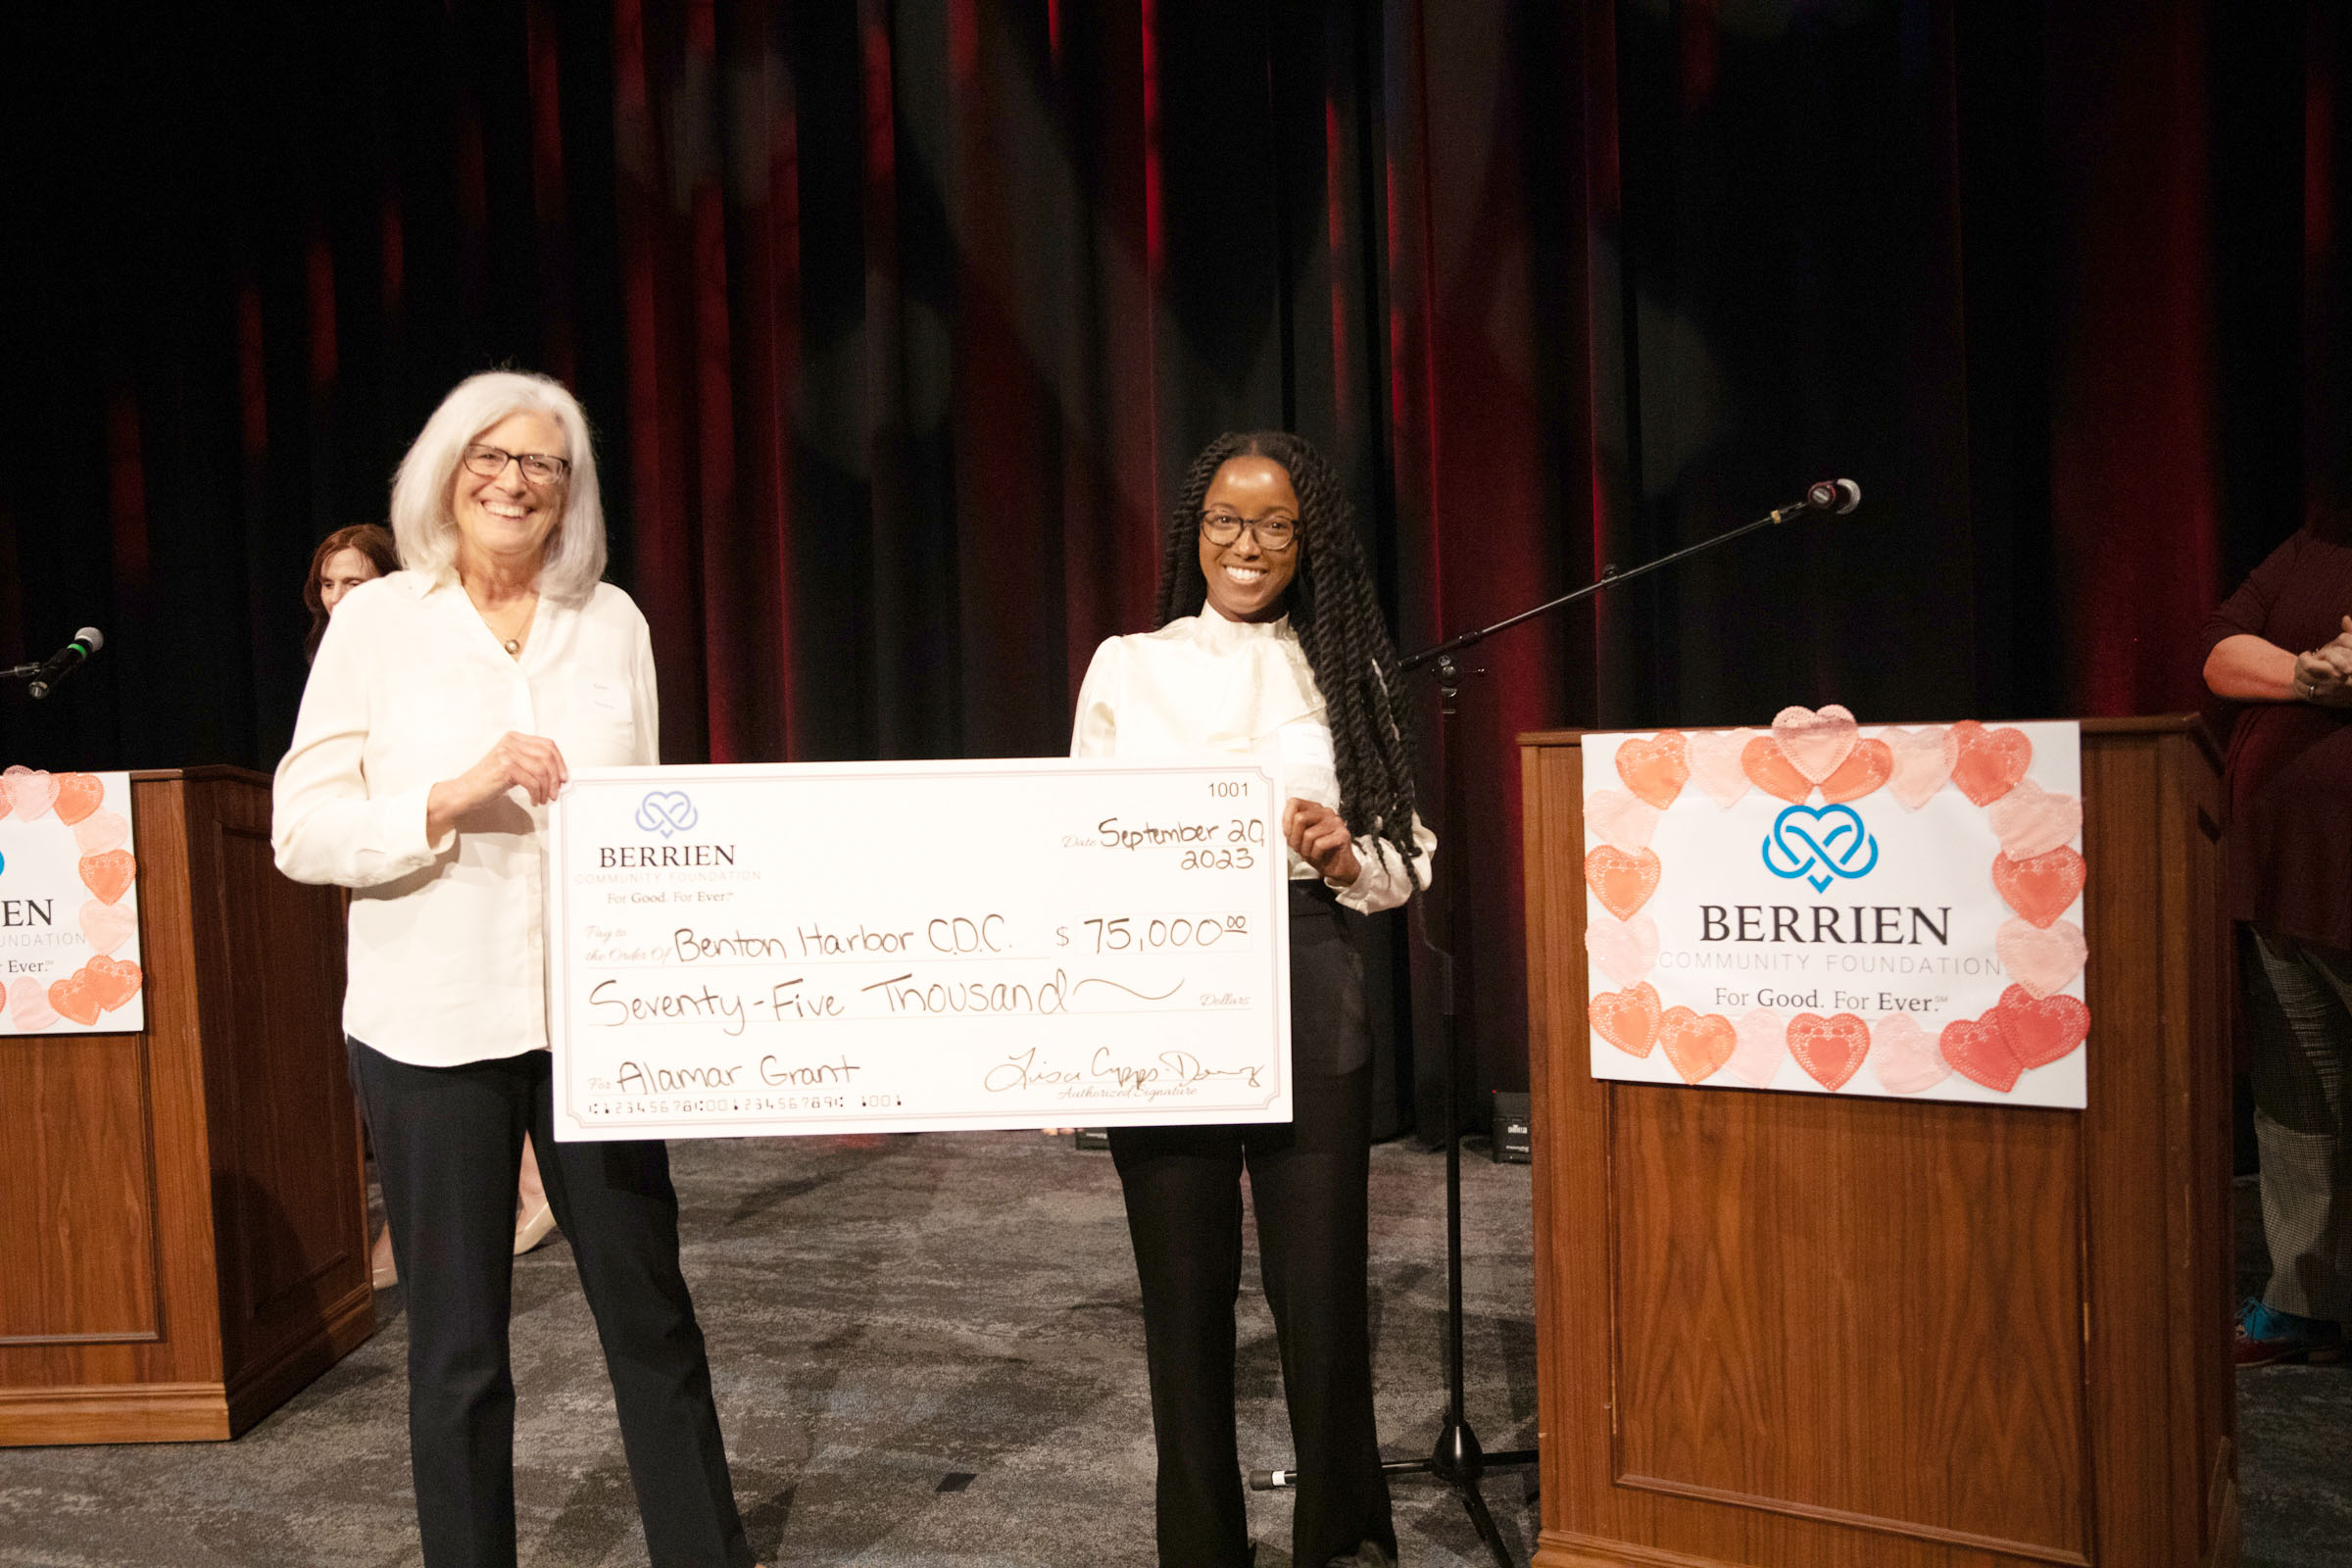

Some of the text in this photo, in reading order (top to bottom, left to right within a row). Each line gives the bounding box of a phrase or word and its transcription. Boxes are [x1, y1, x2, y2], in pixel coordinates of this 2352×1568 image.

[1209, 781, 1249, 798] 1001
[1098, 817, 1219, 851] September
[599, 845, 735, 868] BERRIEN
[1180, 848, 1254, 870] 2023
[574, 870, 761, 885] COMMUNITY FOUNDATION
[607, 894, 626, 905] For
[673, 892, 692, 903] For
[1, 899, 54, 927] EN
[1056, 926, 1070, 947] $
[1698, 905, 1952, 947] BERRIEN
[0, 932, 85, 948] UNDATION
[673, 927, 787, 962] Benton
[797, 923, 913, 957] Harbor
[1659, 952, 2001, 976] COMMUNITY FOUNDATION
[589, 967, 1068, 1037] Seventy-Five Thousand
[1199, 993, 1251, 1005] Dollars
[1715, 987, 1749, 1006] For
[1757, 988, 1825, 1008] Good.
[1834, 990, 1870, 1010] For
[615, 1054, 861, 1096] Alamar Grant
[1056, 1085, 1199, 1102] Authorized Signature
